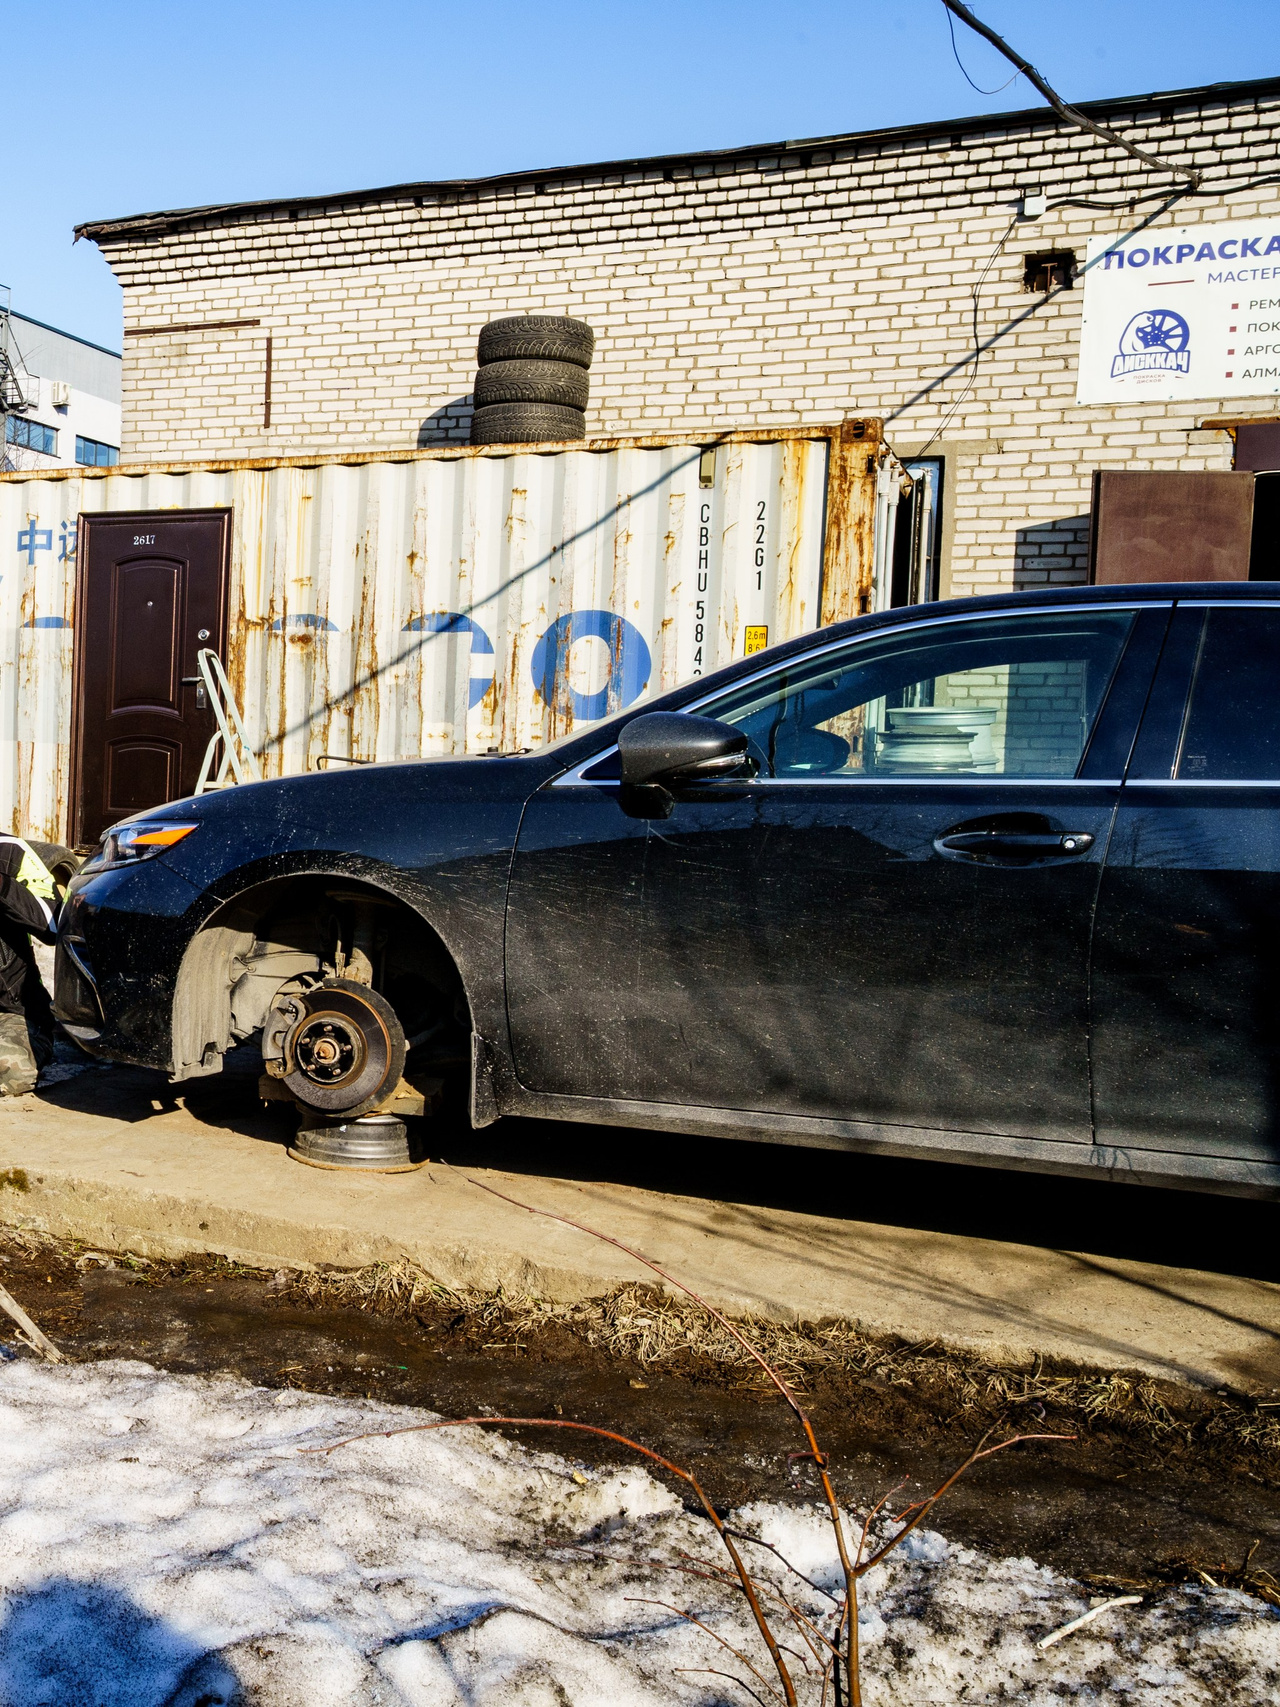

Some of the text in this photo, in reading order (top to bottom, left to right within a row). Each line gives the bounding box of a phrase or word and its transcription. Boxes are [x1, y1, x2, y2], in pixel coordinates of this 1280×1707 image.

[1104, 235, 1280, 270] ПОКРАСКА
[1207, 266, 1280, 284] МАСТЕР
[1112, 351, 1188, 377] ДИСККАЧ
[1241, 367, 1280, 379] АЛМ
[133, 534, 156, 545] 2617
[754, 501, 766, 590] 22G1
[693, 503, 710, 675] CBHU 584
